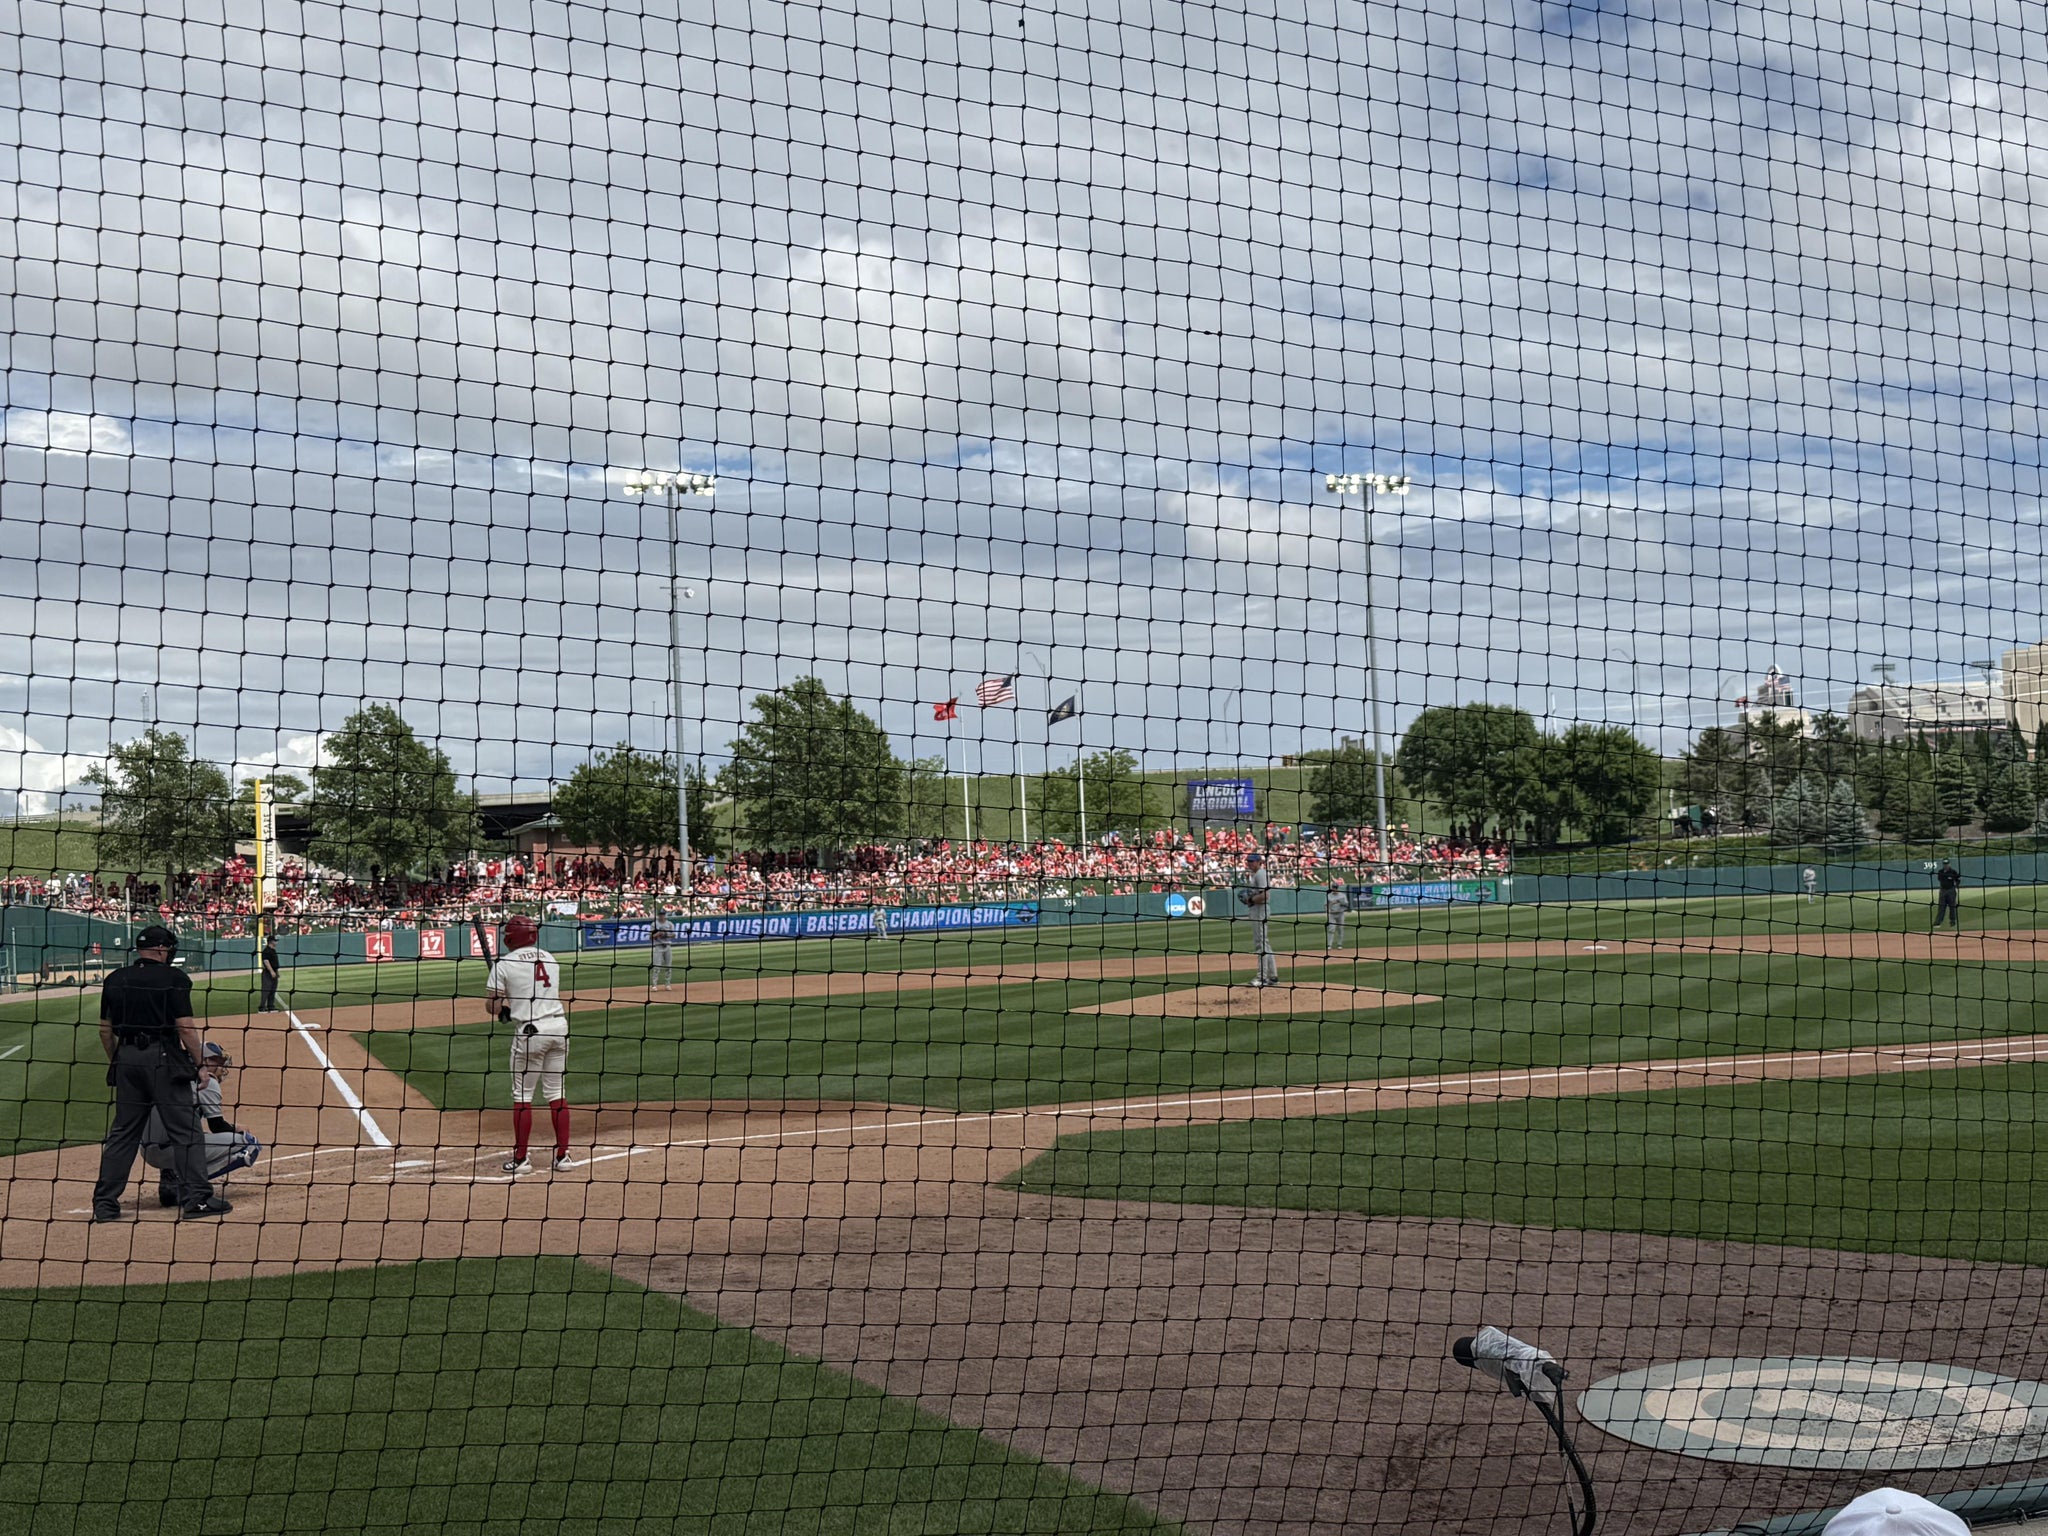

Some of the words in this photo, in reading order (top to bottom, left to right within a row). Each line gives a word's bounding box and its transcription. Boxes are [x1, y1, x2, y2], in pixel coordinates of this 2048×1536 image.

[1195, 783, 1246, 798] LINCOLN
[1192, 796, 1250, 811] REGIONAL
[716, 917, 792, 937] DIVISION
[889, 906, 1010, 929] CHAMPIONSHIP
[373, 939, 386, 954] 4
[421, 937, 441, 951] 17
[536, 961, 552, 988] 4
